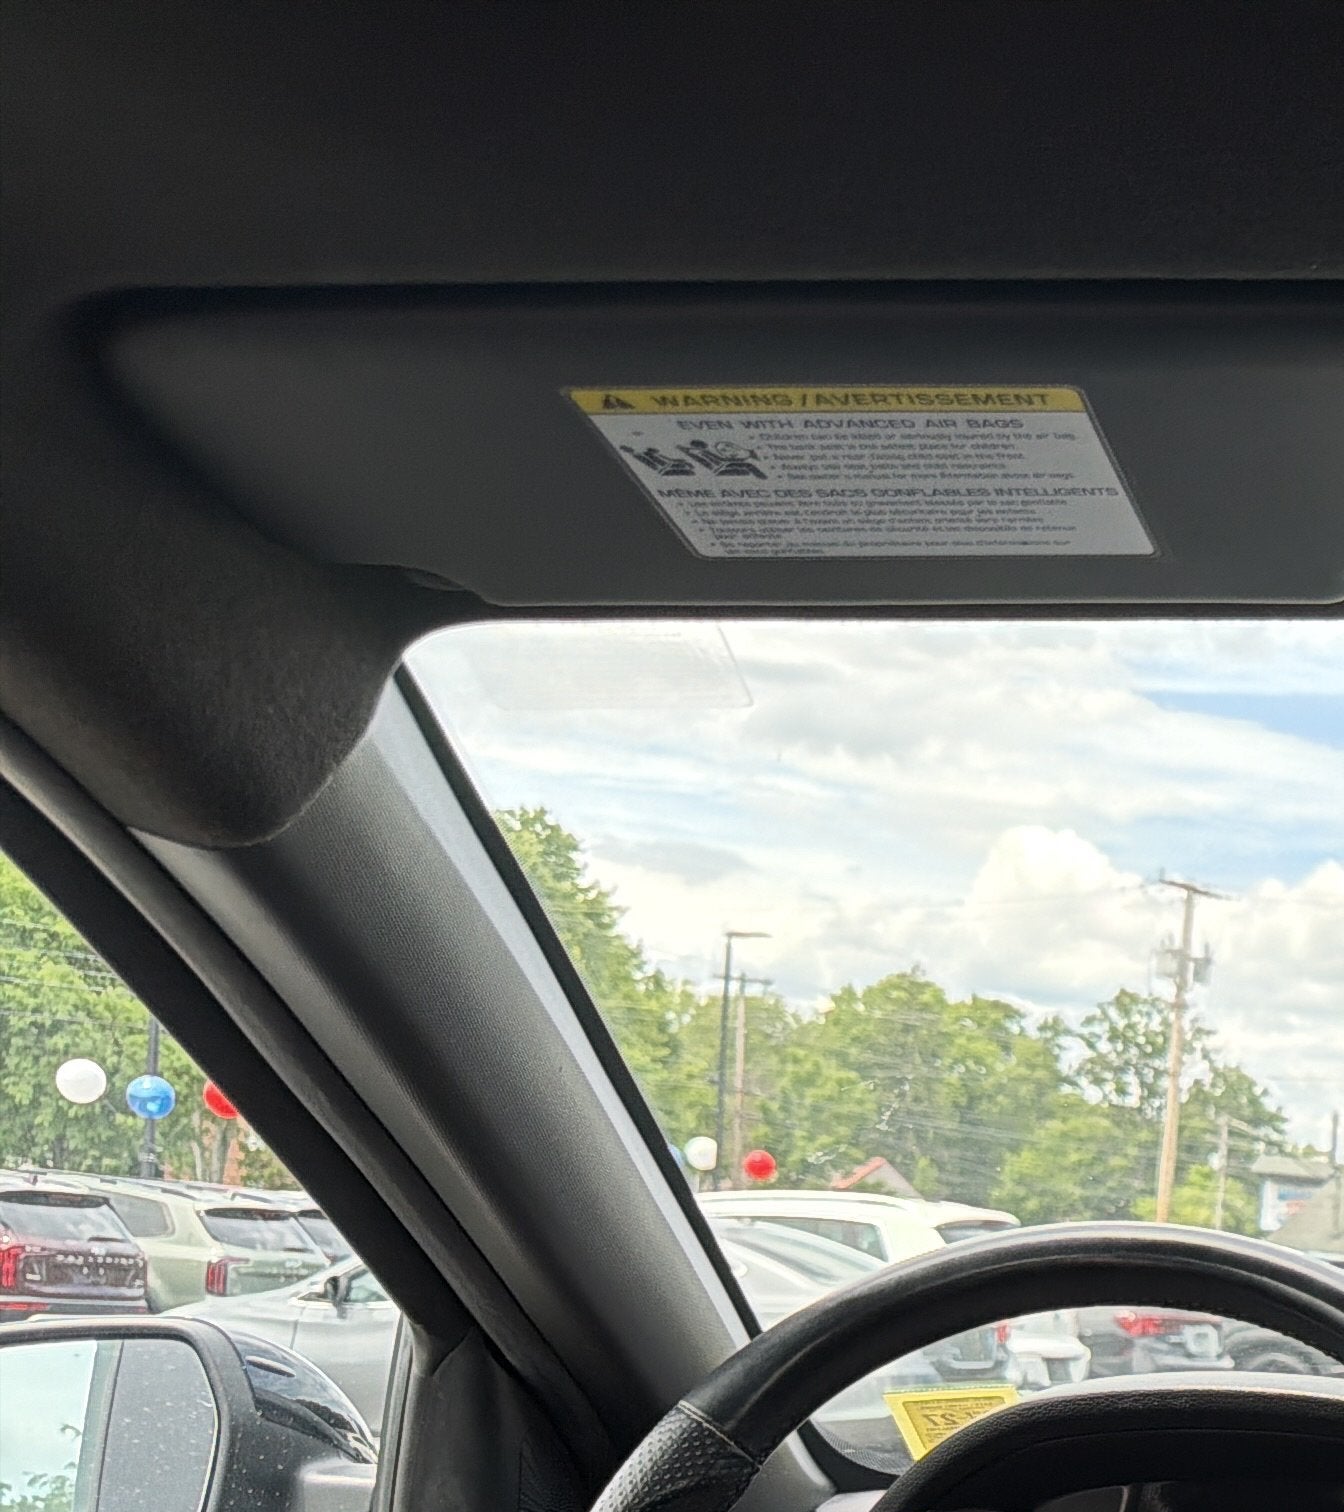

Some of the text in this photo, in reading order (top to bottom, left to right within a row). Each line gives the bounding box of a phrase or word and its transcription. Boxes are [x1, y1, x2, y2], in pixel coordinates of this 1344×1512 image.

[677, 418, 1024, 430] EVEN WITH ADVANCED AIR BAGS
